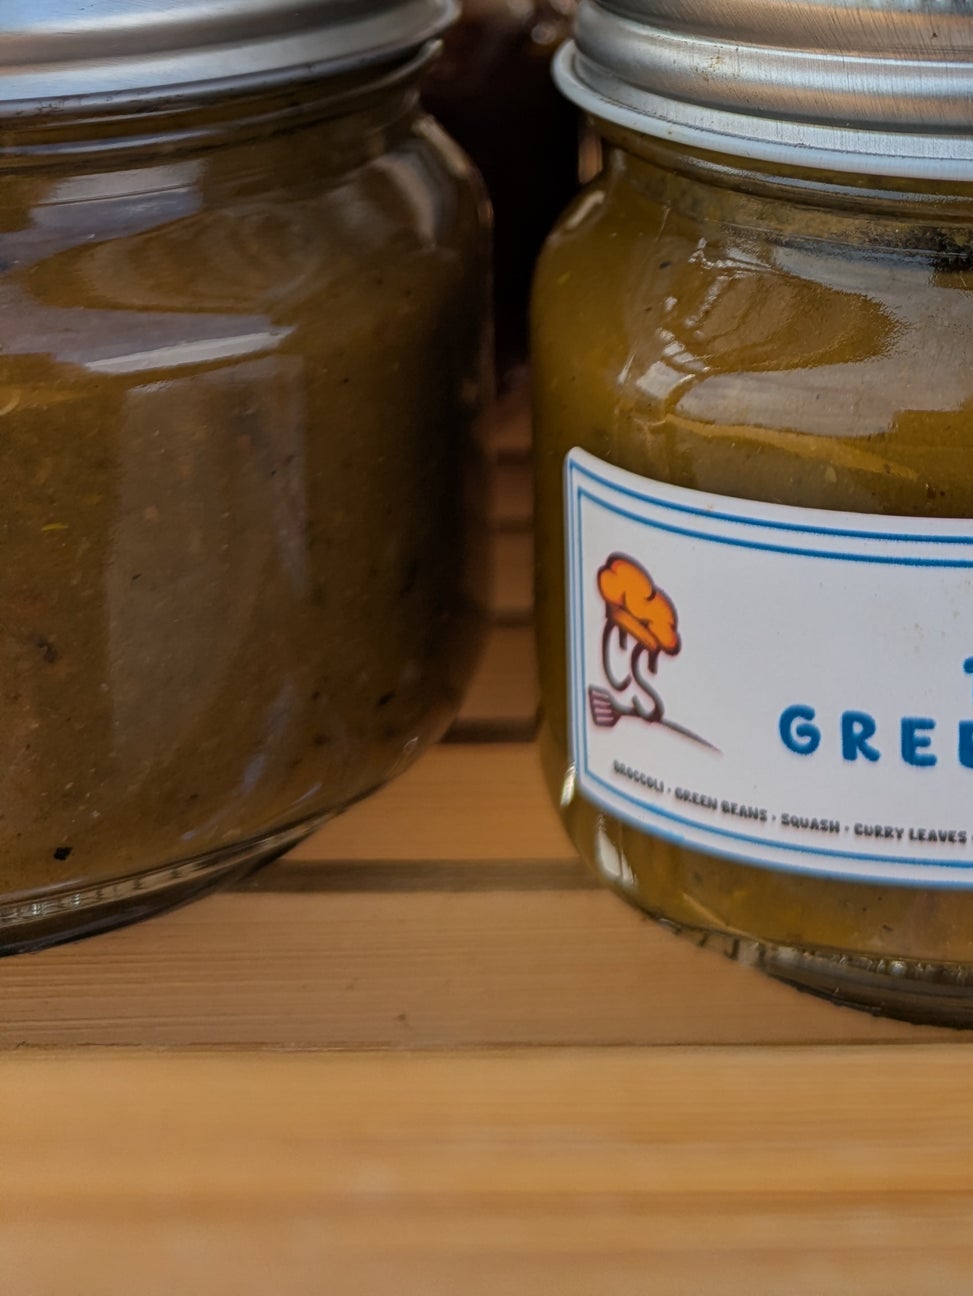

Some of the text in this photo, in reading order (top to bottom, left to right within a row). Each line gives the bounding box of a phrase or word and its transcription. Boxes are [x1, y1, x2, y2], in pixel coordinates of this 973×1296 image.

[613, 759, 665, 793] BROCCOLI
[674, 786, 718, 810] GREEN
[720, 800, 768, 821] BEANS
[781, 813, 840, 833] SQUASH
[853, 822, 904, 839] CURRY
[908, 827, 967, 844] LEAVES
